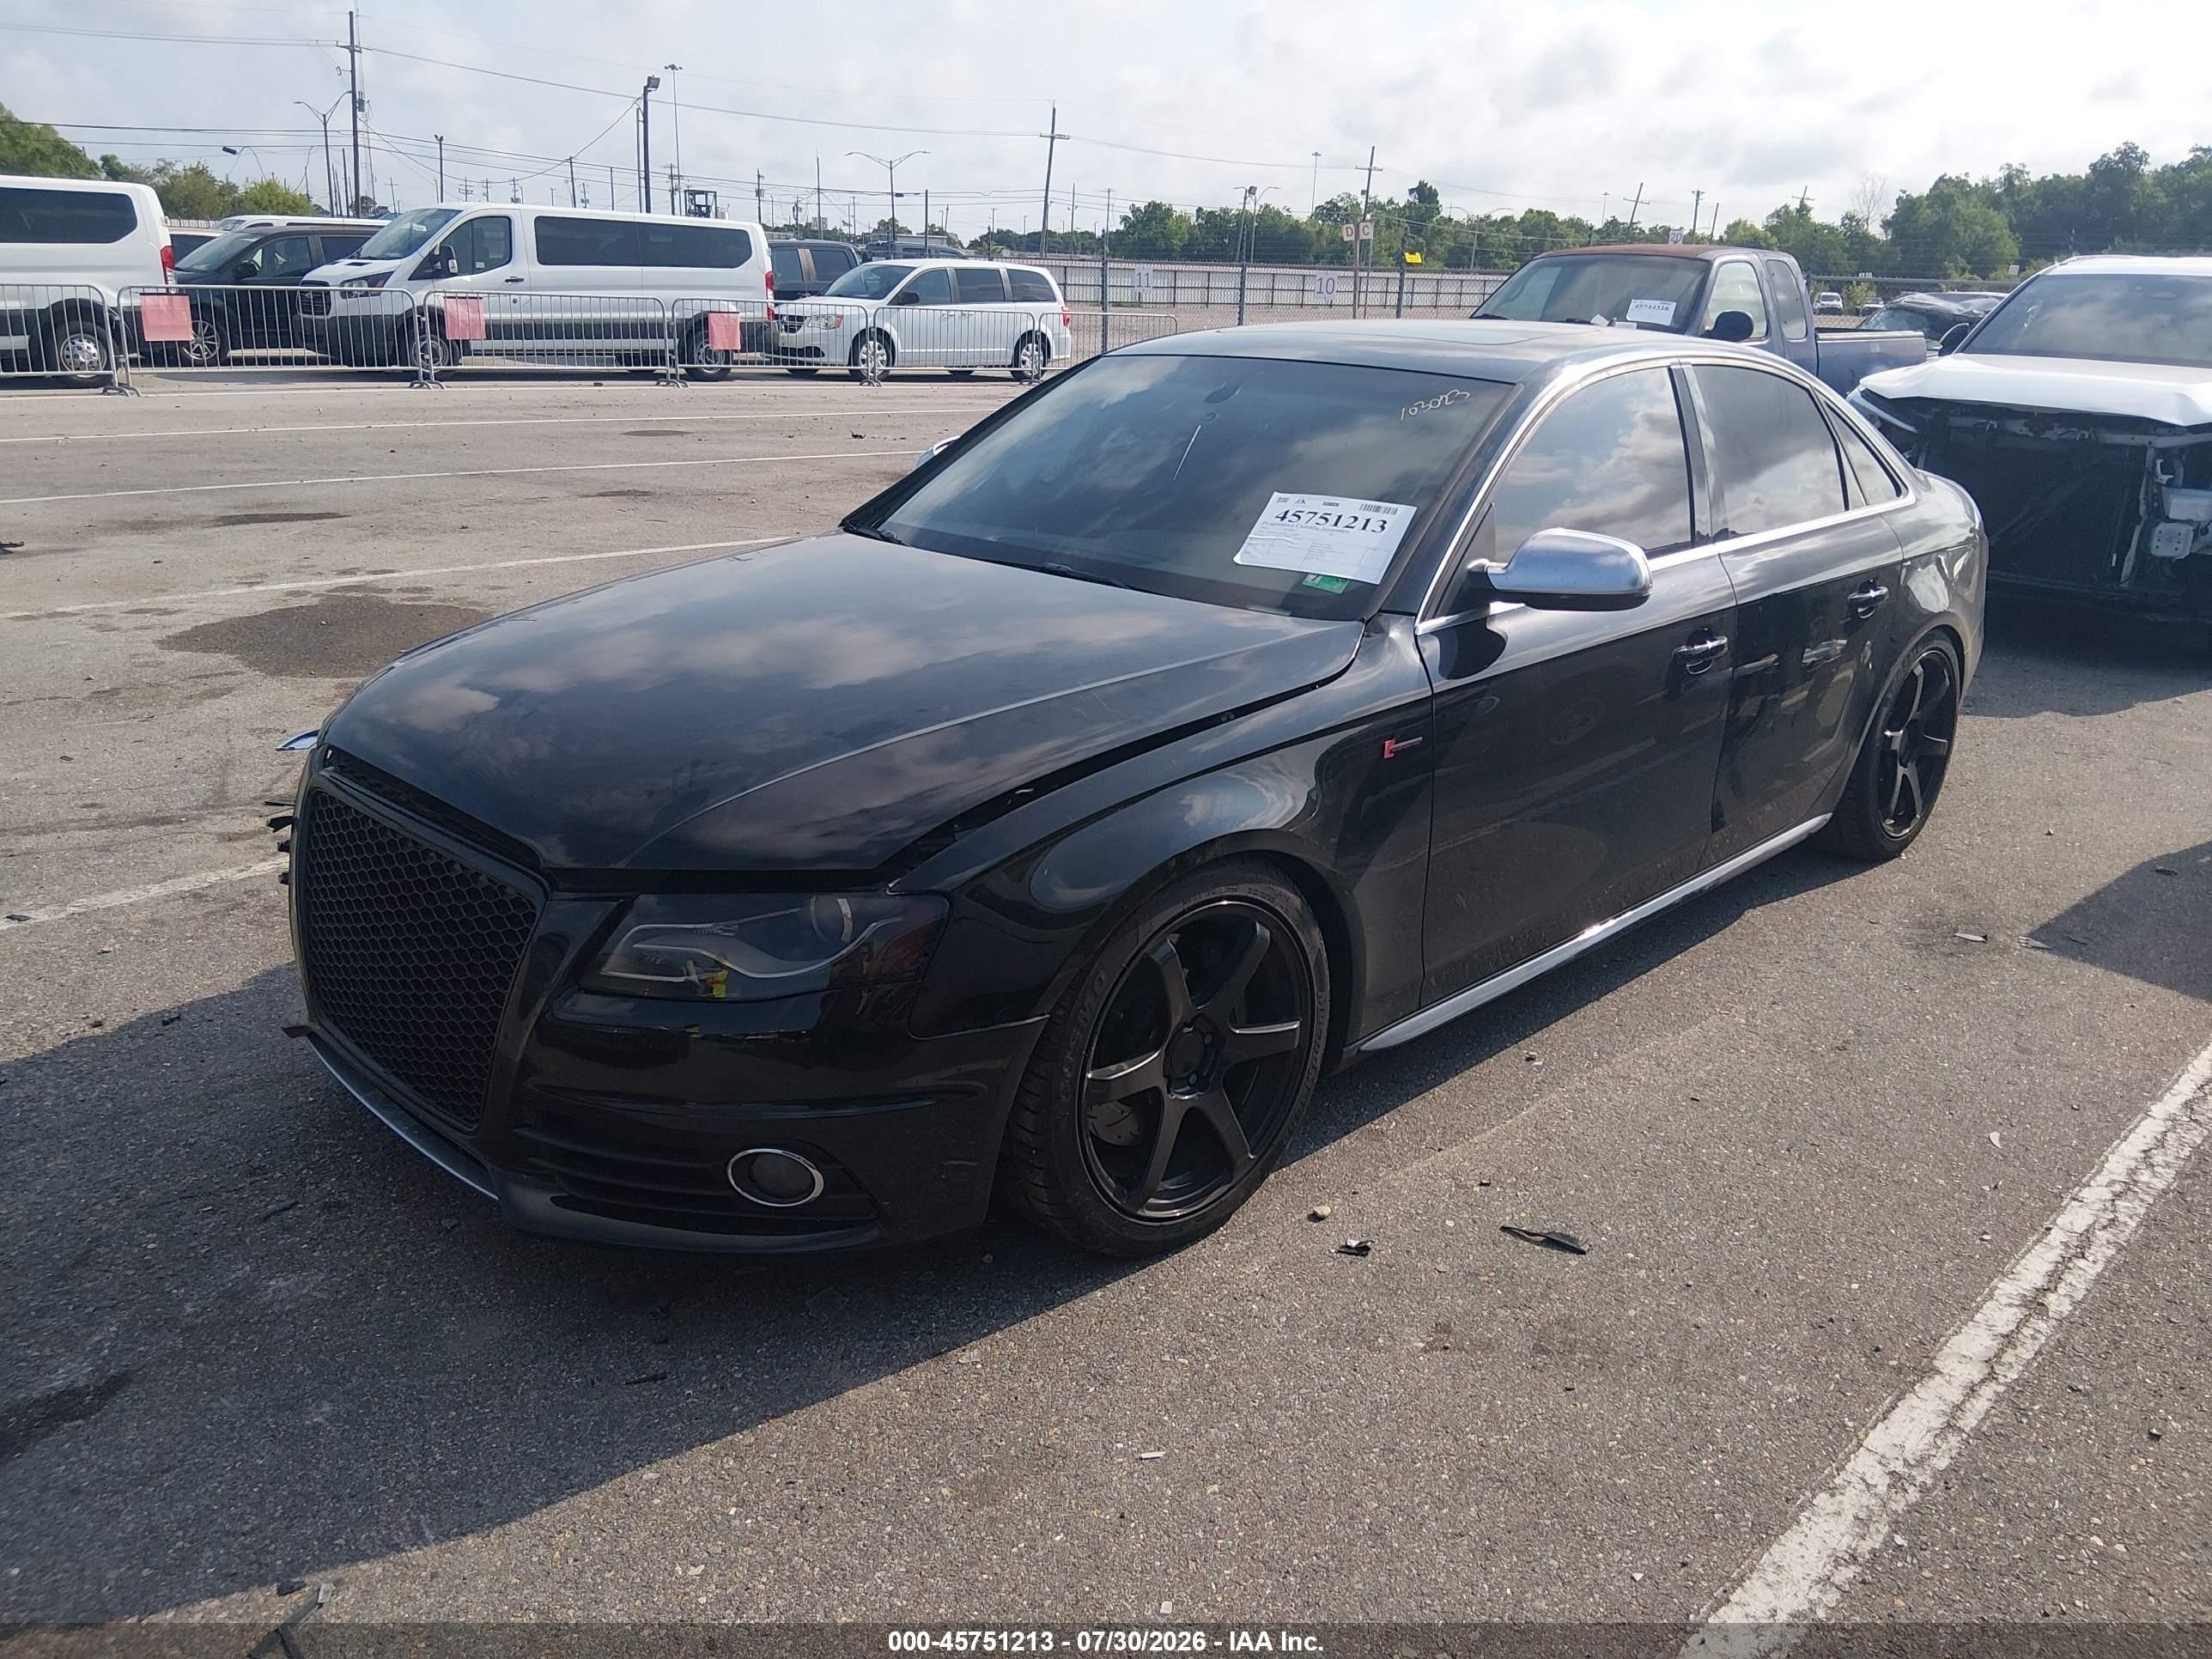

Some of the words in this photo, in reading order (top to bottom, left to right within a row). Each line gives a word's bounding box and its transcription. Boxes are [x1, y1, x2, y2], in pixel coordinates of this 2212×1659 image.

[1346, 226, 1353, 237] D
[1362, 225, 1370, 236] C
[1137, 272, 1151, 288] 11
[1316, 276, 1335, 295] 10
[1275, 509, 1388, 533] 45751213
